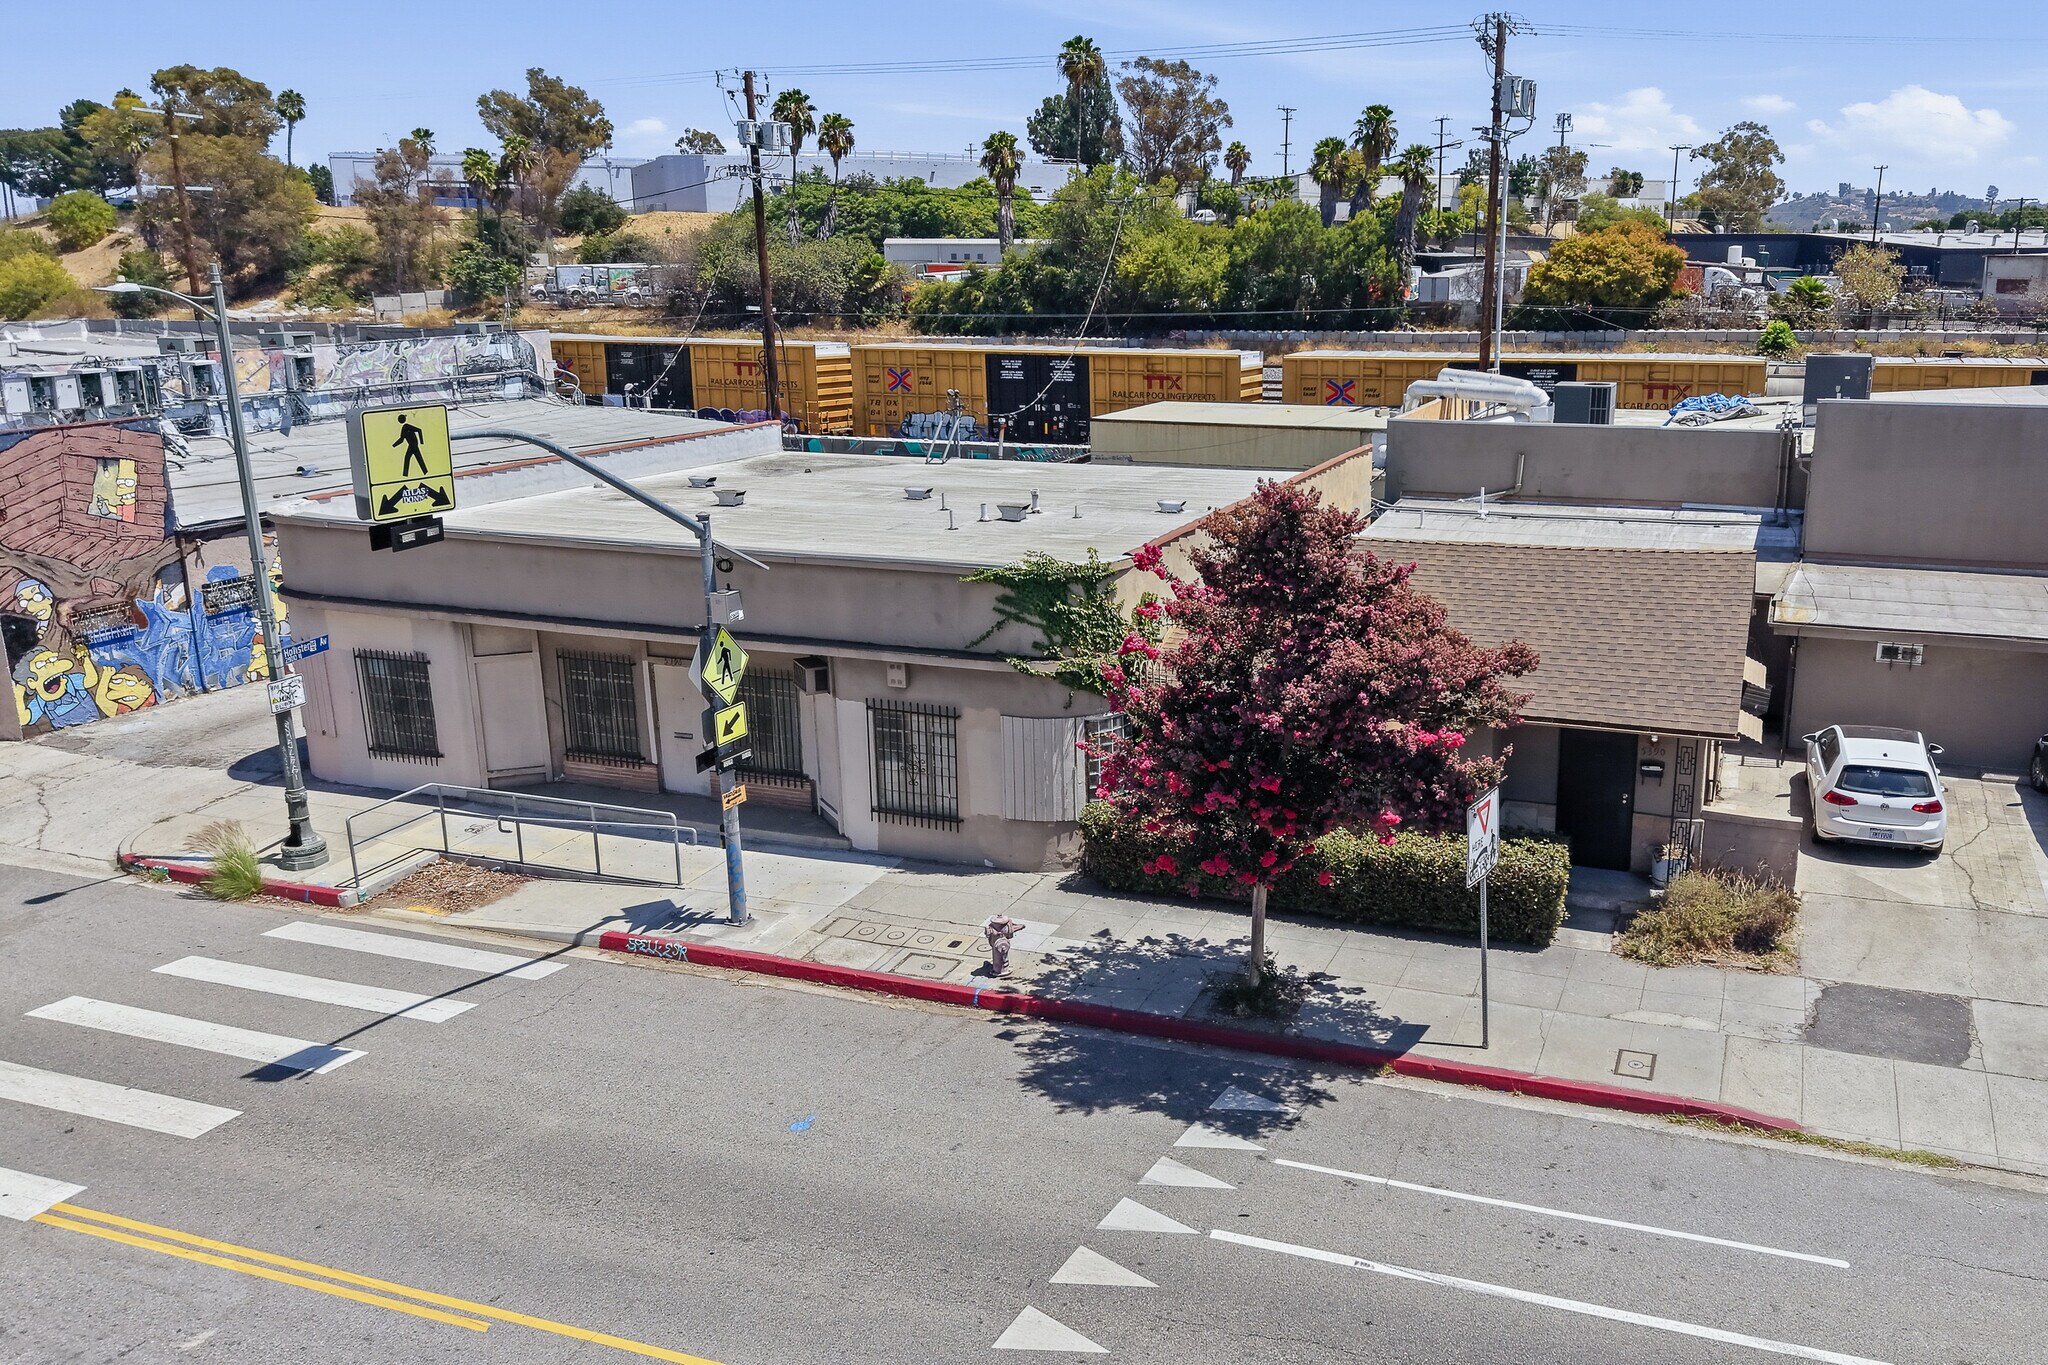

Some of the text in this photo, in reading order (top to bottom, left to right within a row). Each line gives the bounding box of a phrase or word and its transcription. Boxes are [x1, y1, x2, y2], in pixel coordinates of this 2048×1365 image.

[737, 379, 765, 387] POOLIN
[1143, 374, 1183, 390] TTX
[1642, 383, 1692, 401] TTX
